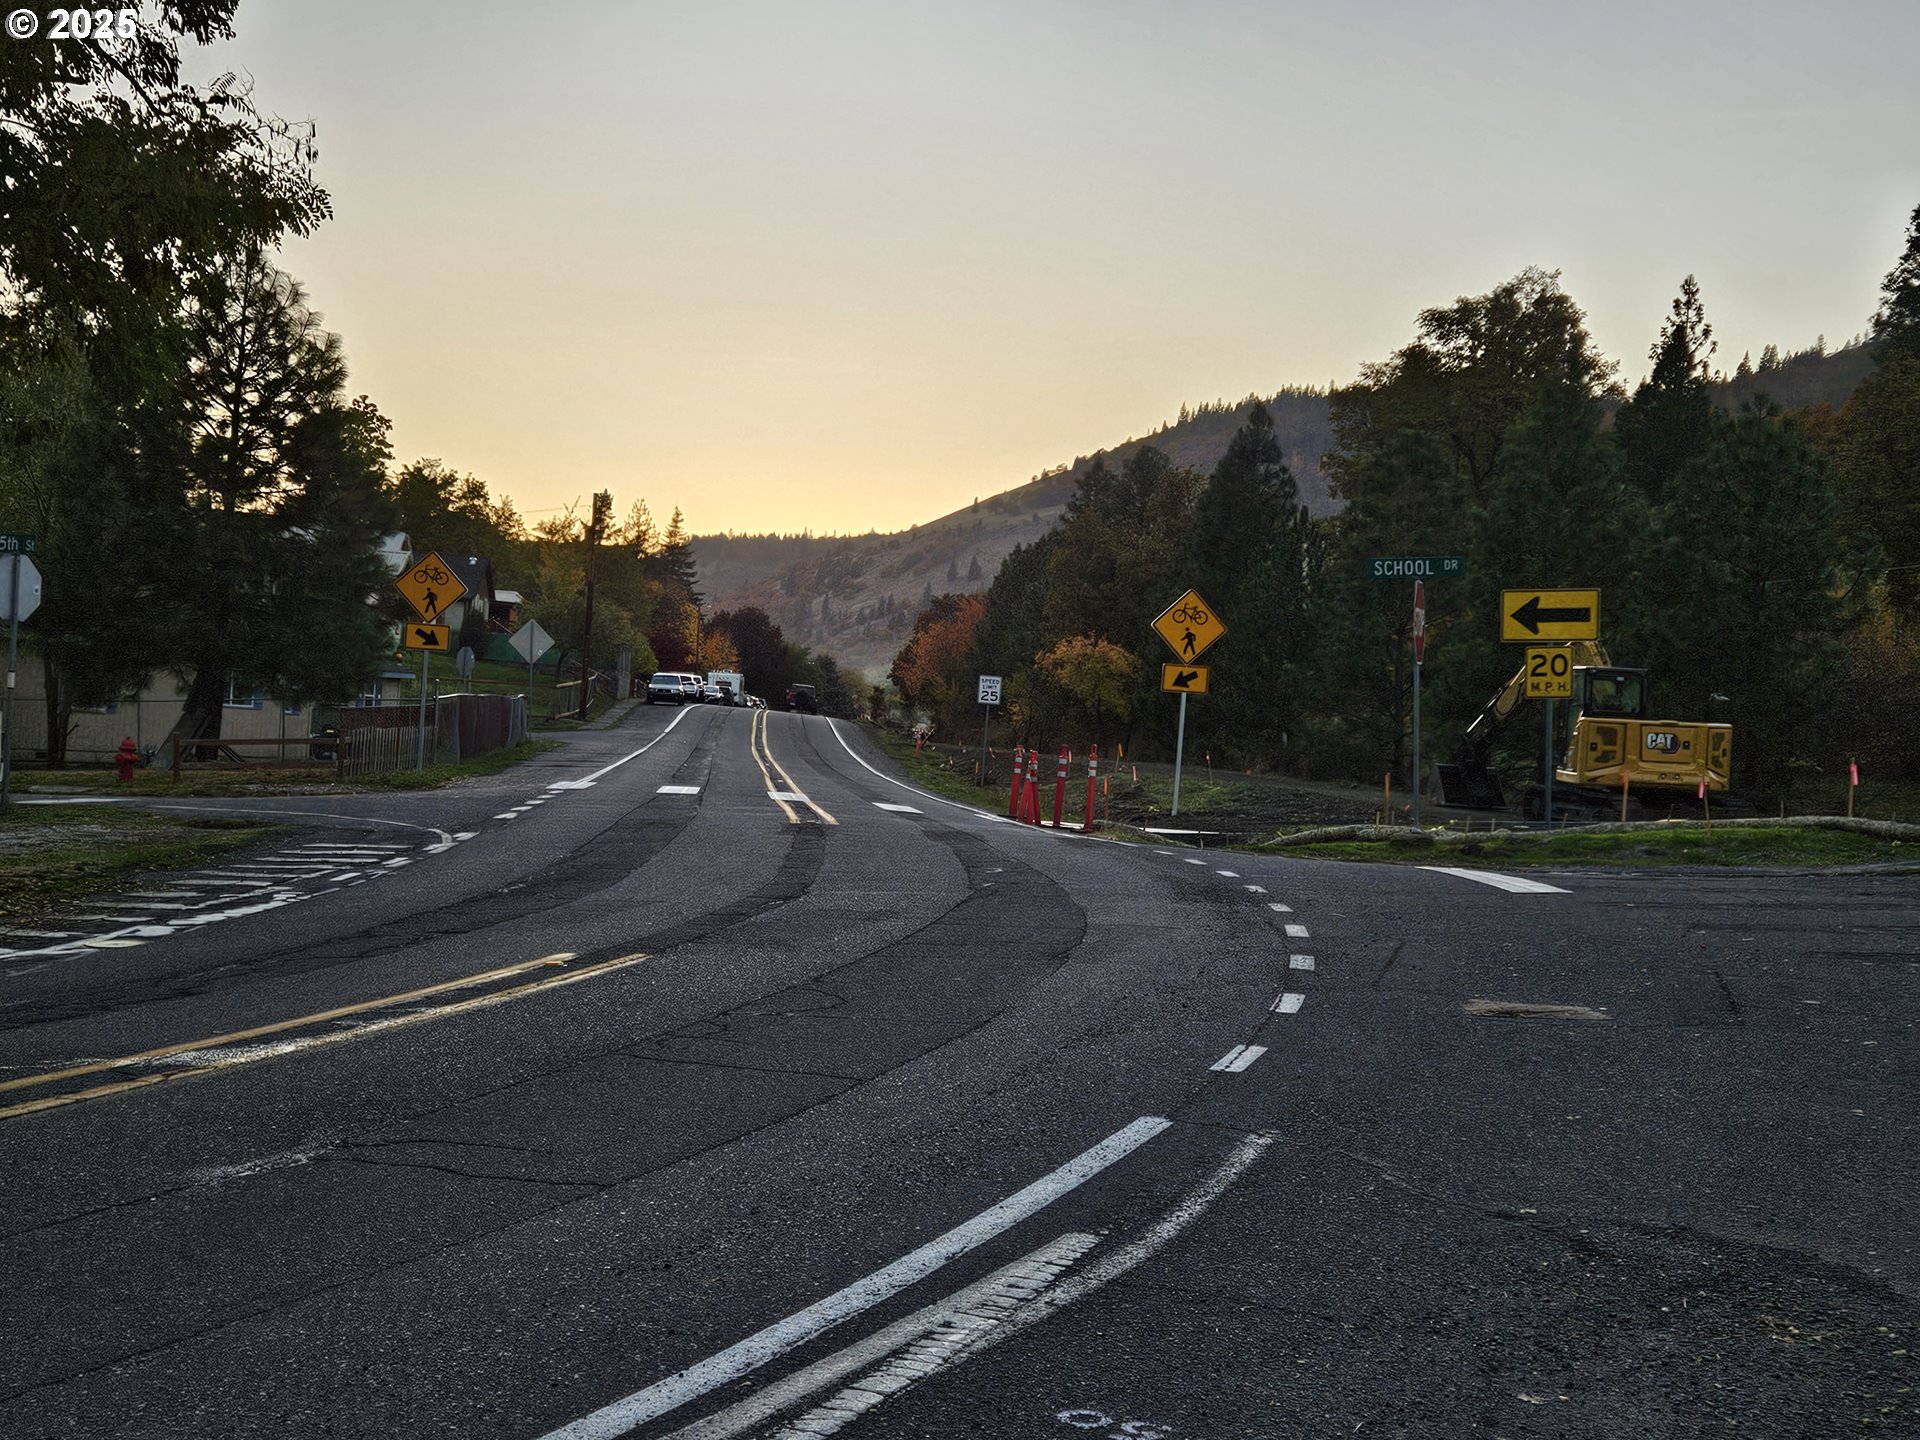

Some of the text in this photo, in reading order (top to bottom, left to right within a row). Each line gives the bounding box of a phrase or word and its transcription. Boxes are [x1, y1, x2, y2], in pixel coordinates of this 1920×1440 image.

[0, 535, 18, 551] 5th
[1374, 559, 1459, 576] SCHOOL DR
[1530, 653, 1568, 677] 20
[980, 690, 999, 702] 25
[1647, 732, 1675, 750] CAT
